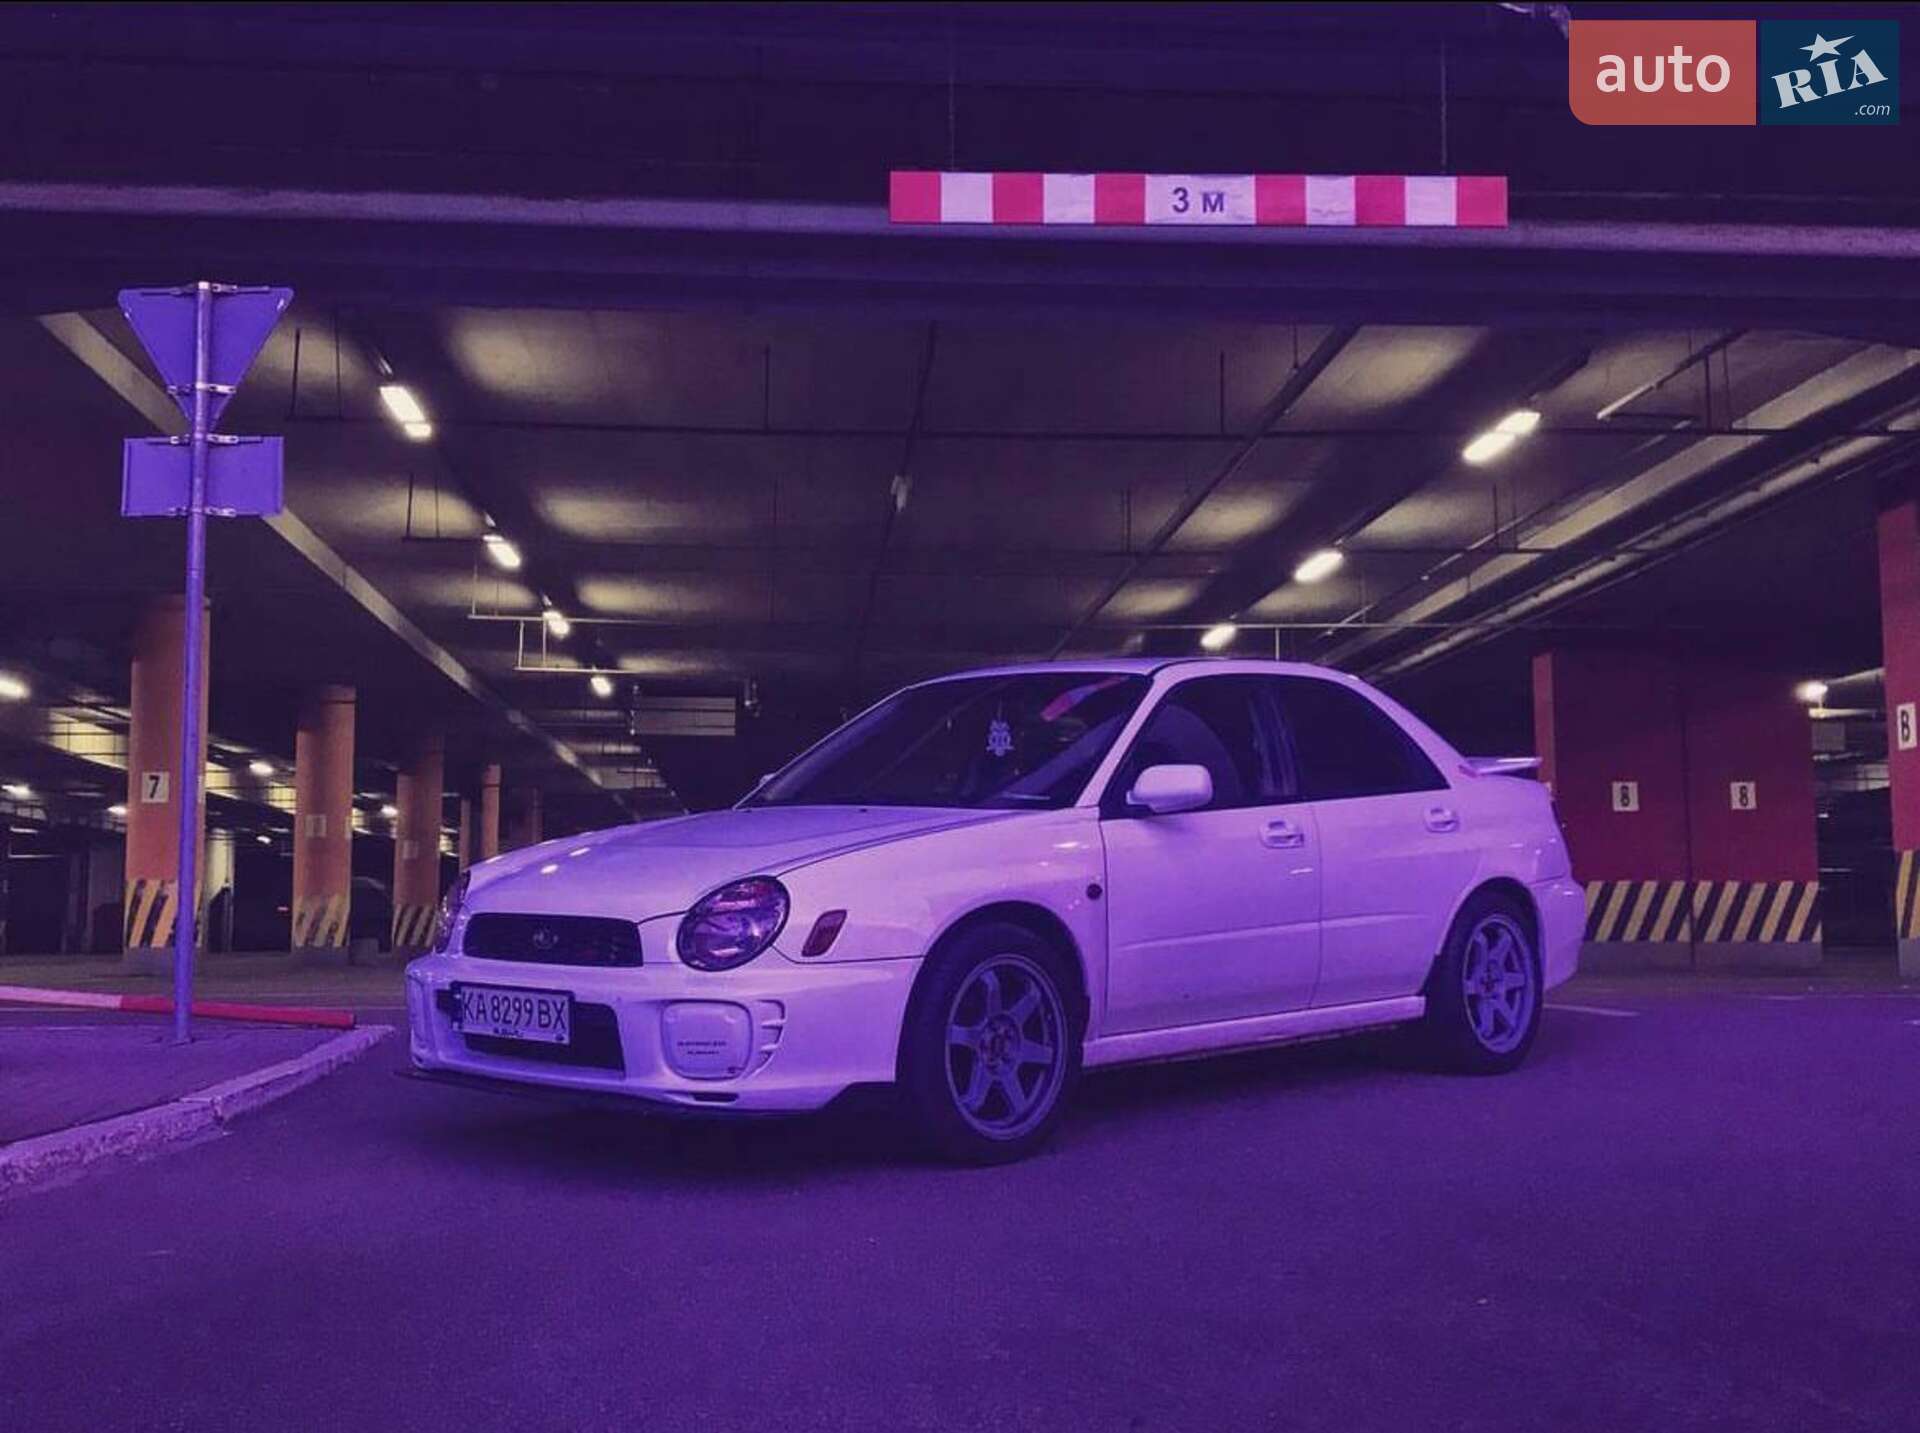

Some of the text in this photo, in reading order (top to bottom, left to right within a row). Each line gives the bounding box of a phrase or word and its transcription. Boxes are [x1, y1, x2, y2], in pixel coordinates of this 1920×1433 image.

[1172, 187, 1189, 213] 3
[149, 775, 160, 799] 7
[1739, 785, 1749, 807] 8
[462, 991, 566, 1029] KA 8299 BX
